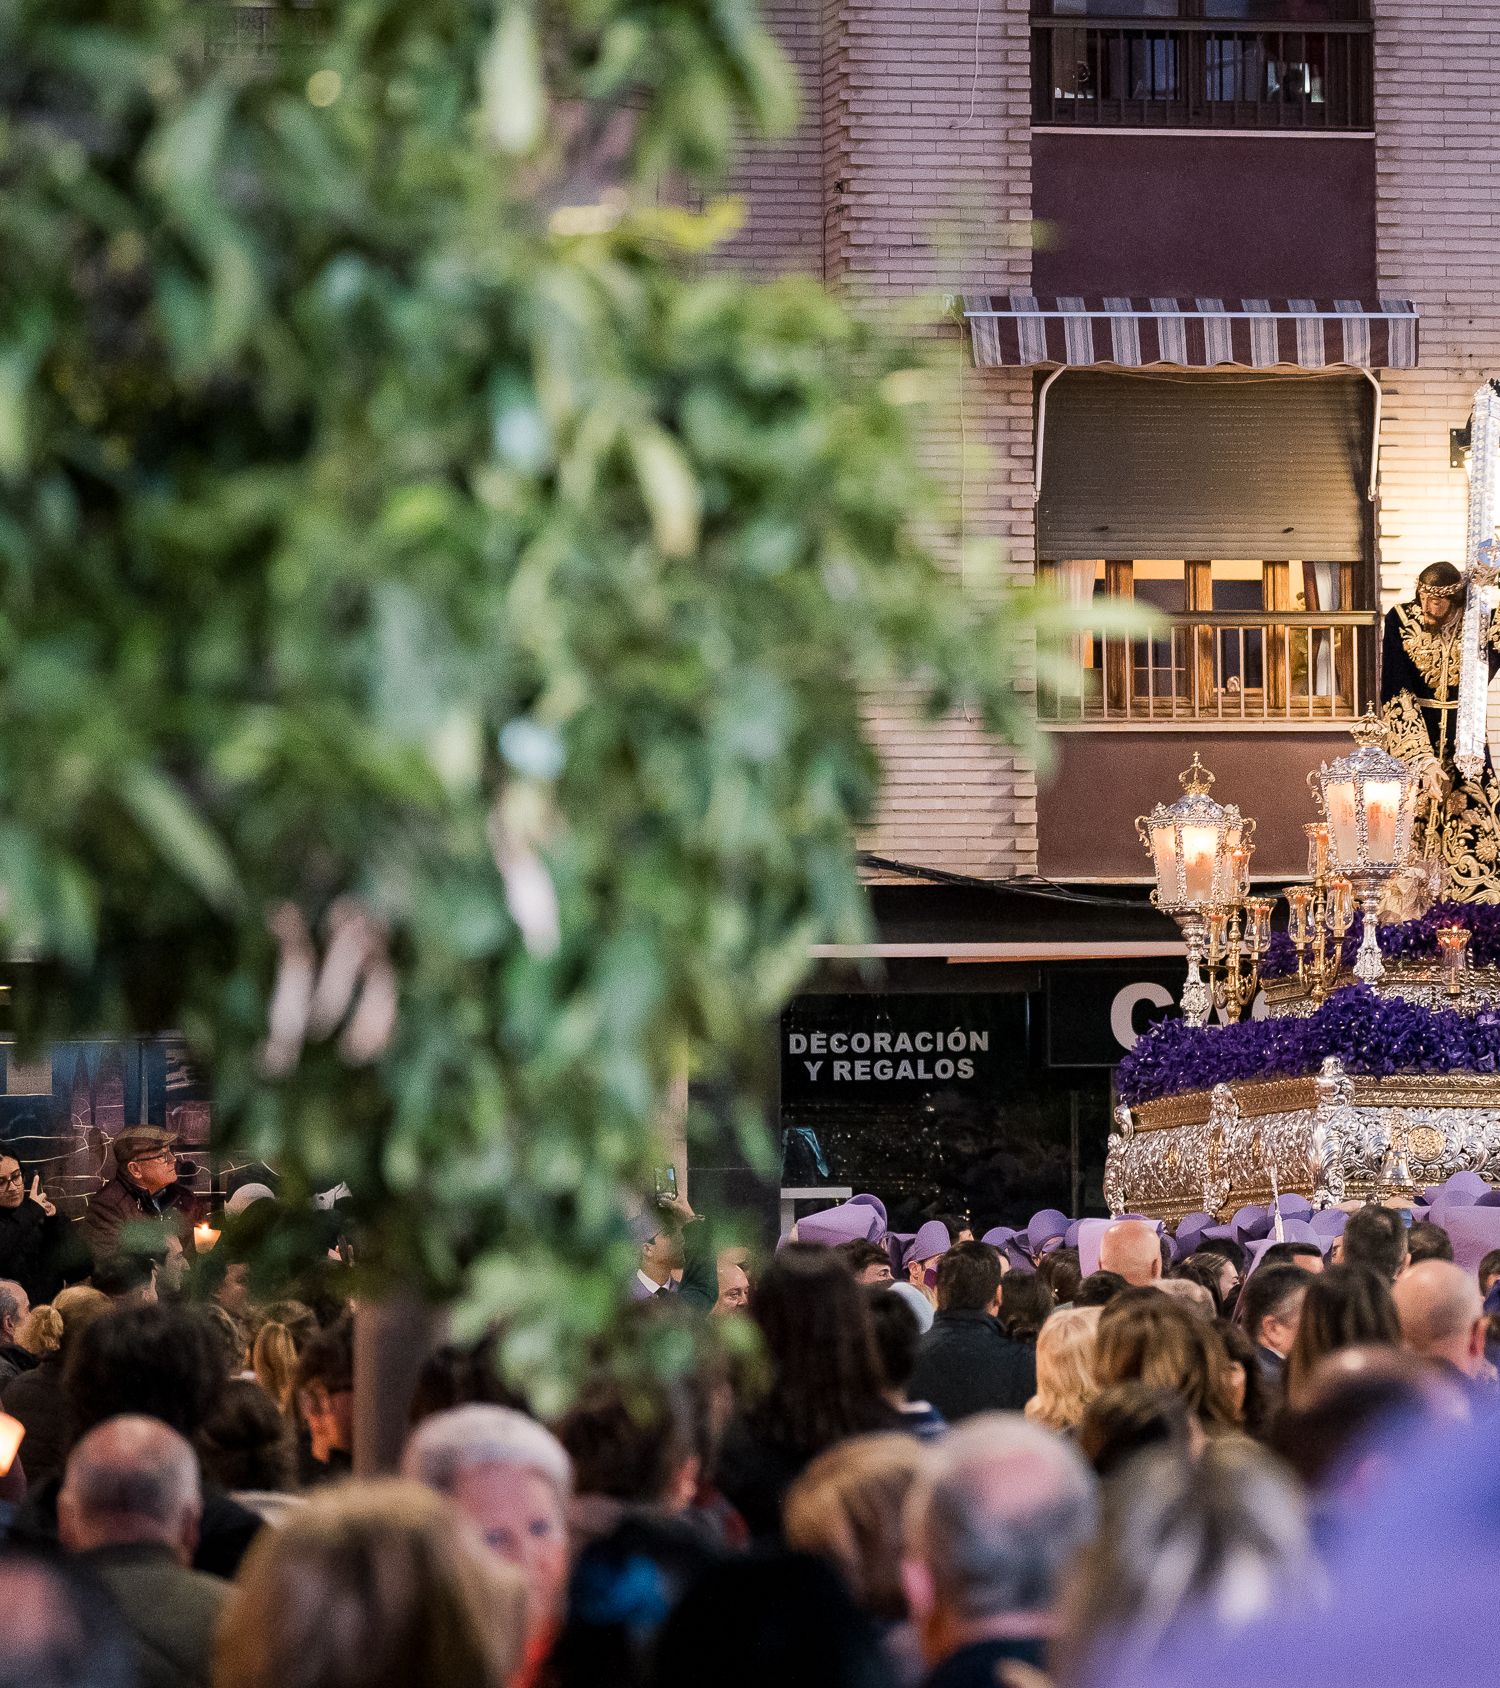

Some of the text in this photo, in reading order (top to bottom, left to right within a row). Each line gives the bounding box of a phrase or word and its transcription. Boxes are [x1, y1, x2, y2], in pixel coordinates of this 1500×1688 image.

[788, 1026, 989, 1055] DECORACIÓN
[803, 1057, 975, 1082] Y REGALOS
